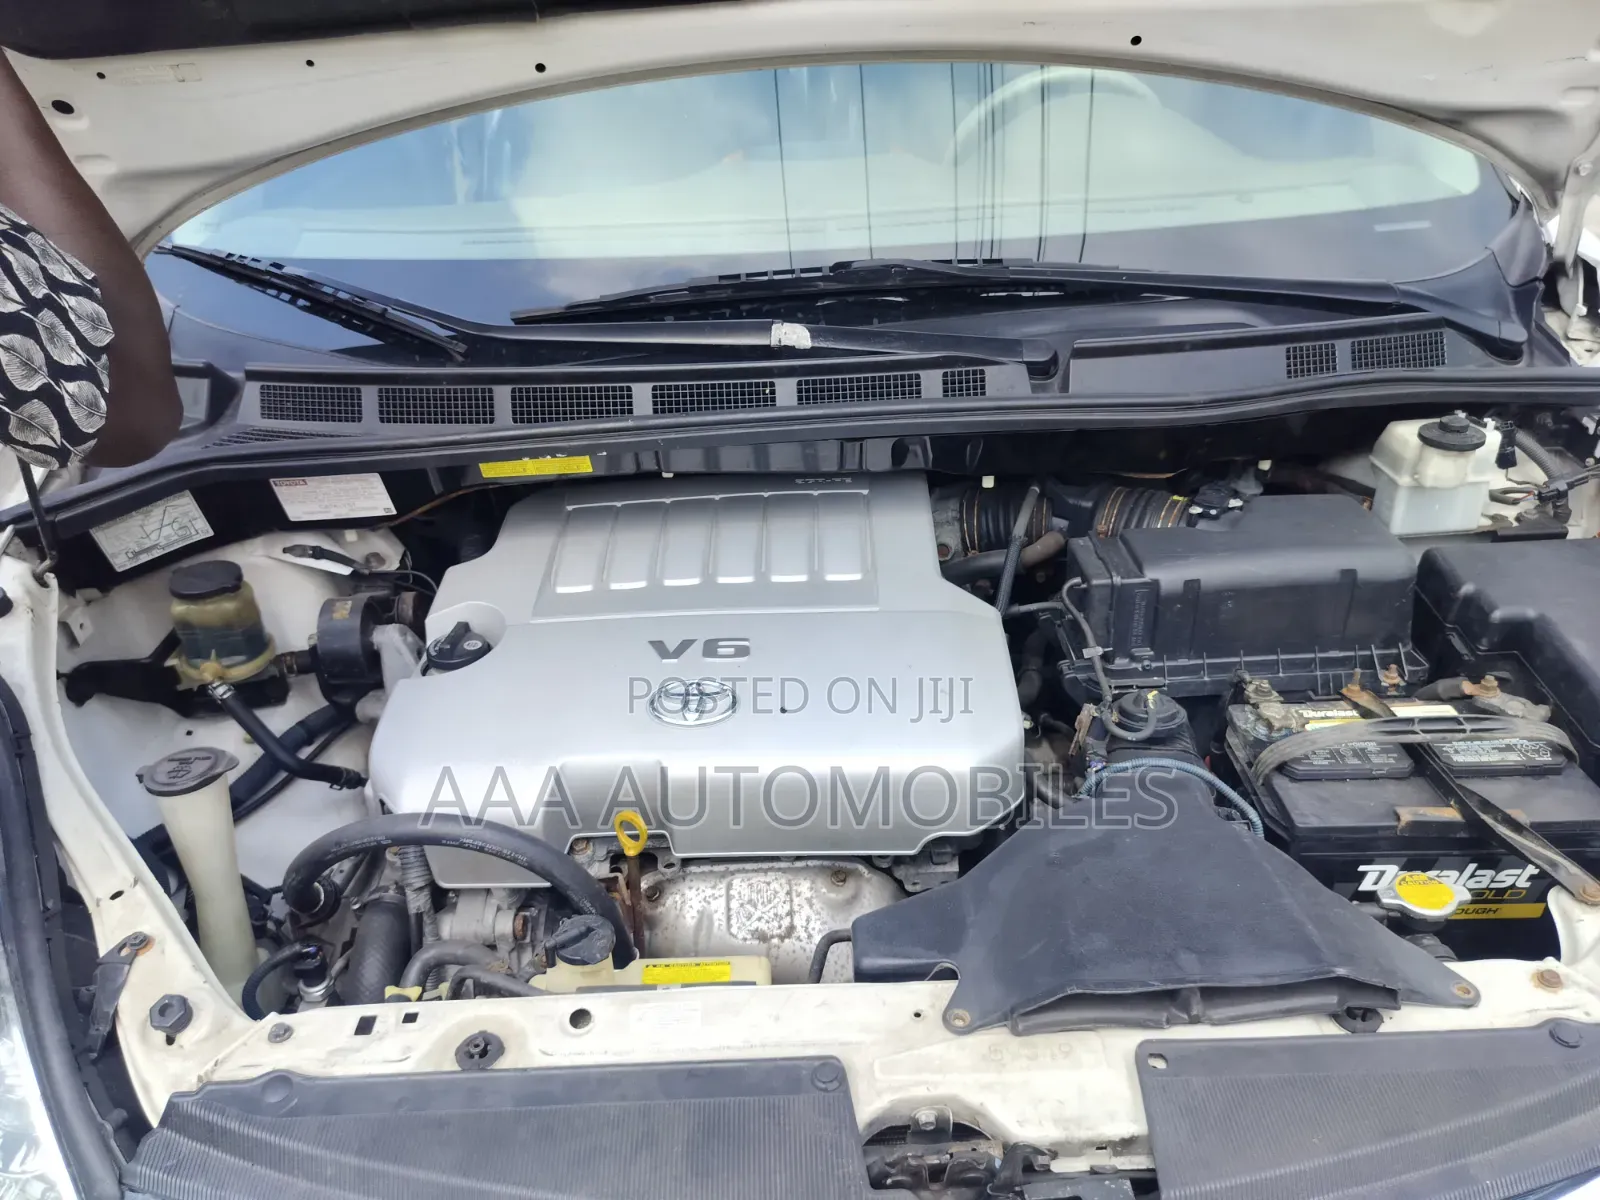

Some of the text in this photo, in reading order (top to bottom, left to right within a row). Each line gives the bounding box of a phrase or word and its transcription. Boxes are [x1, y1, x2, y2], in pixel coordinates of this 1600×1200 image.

[274, 479, 307, 487] TOYOTA
[648, 637, 751, 661] V6
[1299, 709, 1361, 718] Duralast
[1357, 863, 1541, 891] Dalast
[1469, 889, 1528, 900] OLD
[1454, 907, 1499, 916] OUGH
